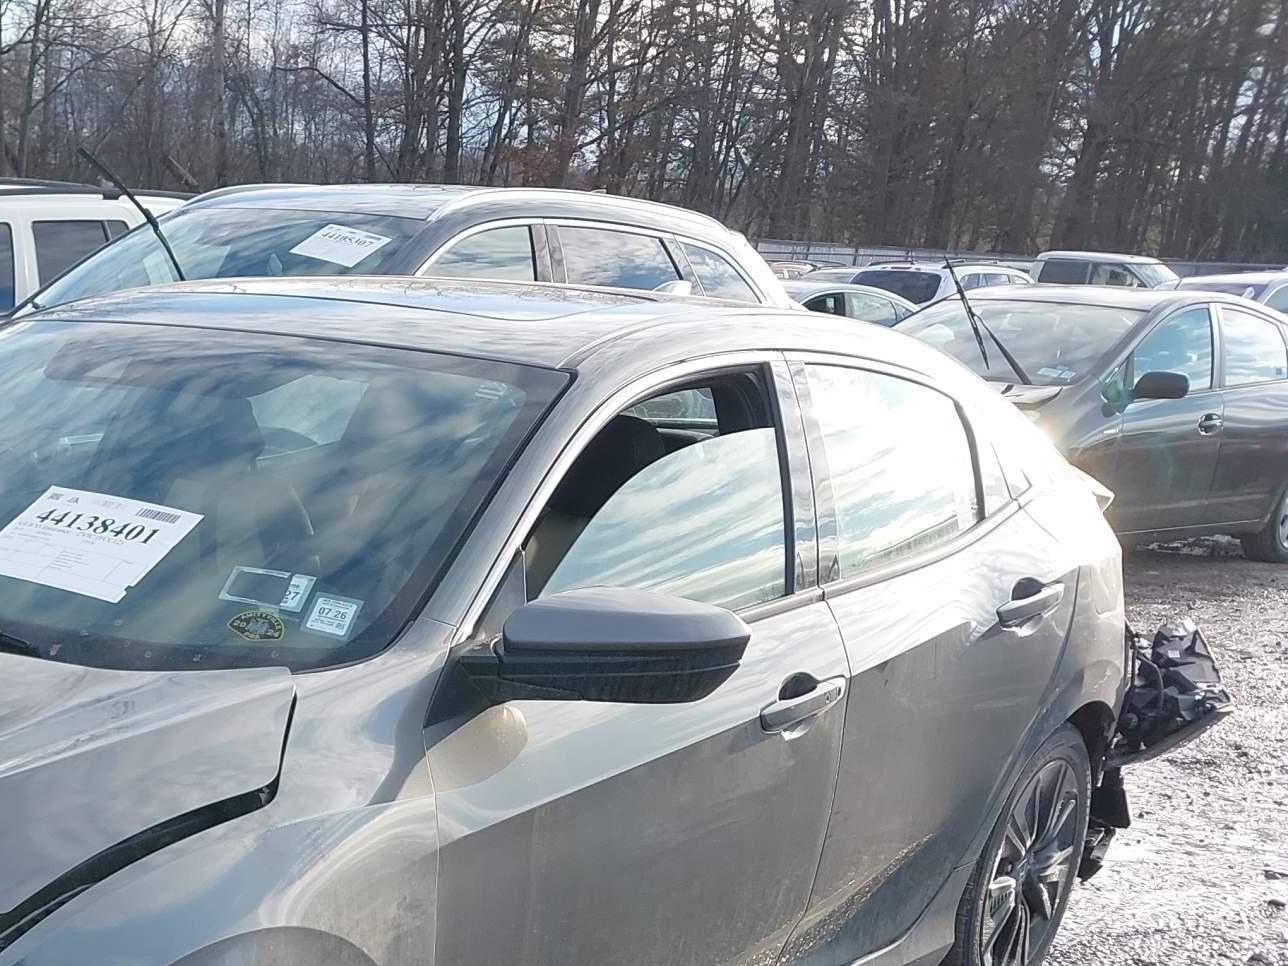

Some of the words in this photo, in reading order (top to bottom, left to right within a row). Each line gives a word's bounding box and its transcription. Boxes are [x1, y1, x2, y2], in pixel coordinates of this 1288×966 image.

[36, 508, 159, 544] 44138401
[318, 606, 332, 615] 07
[333, 610, 348, 620] 26
